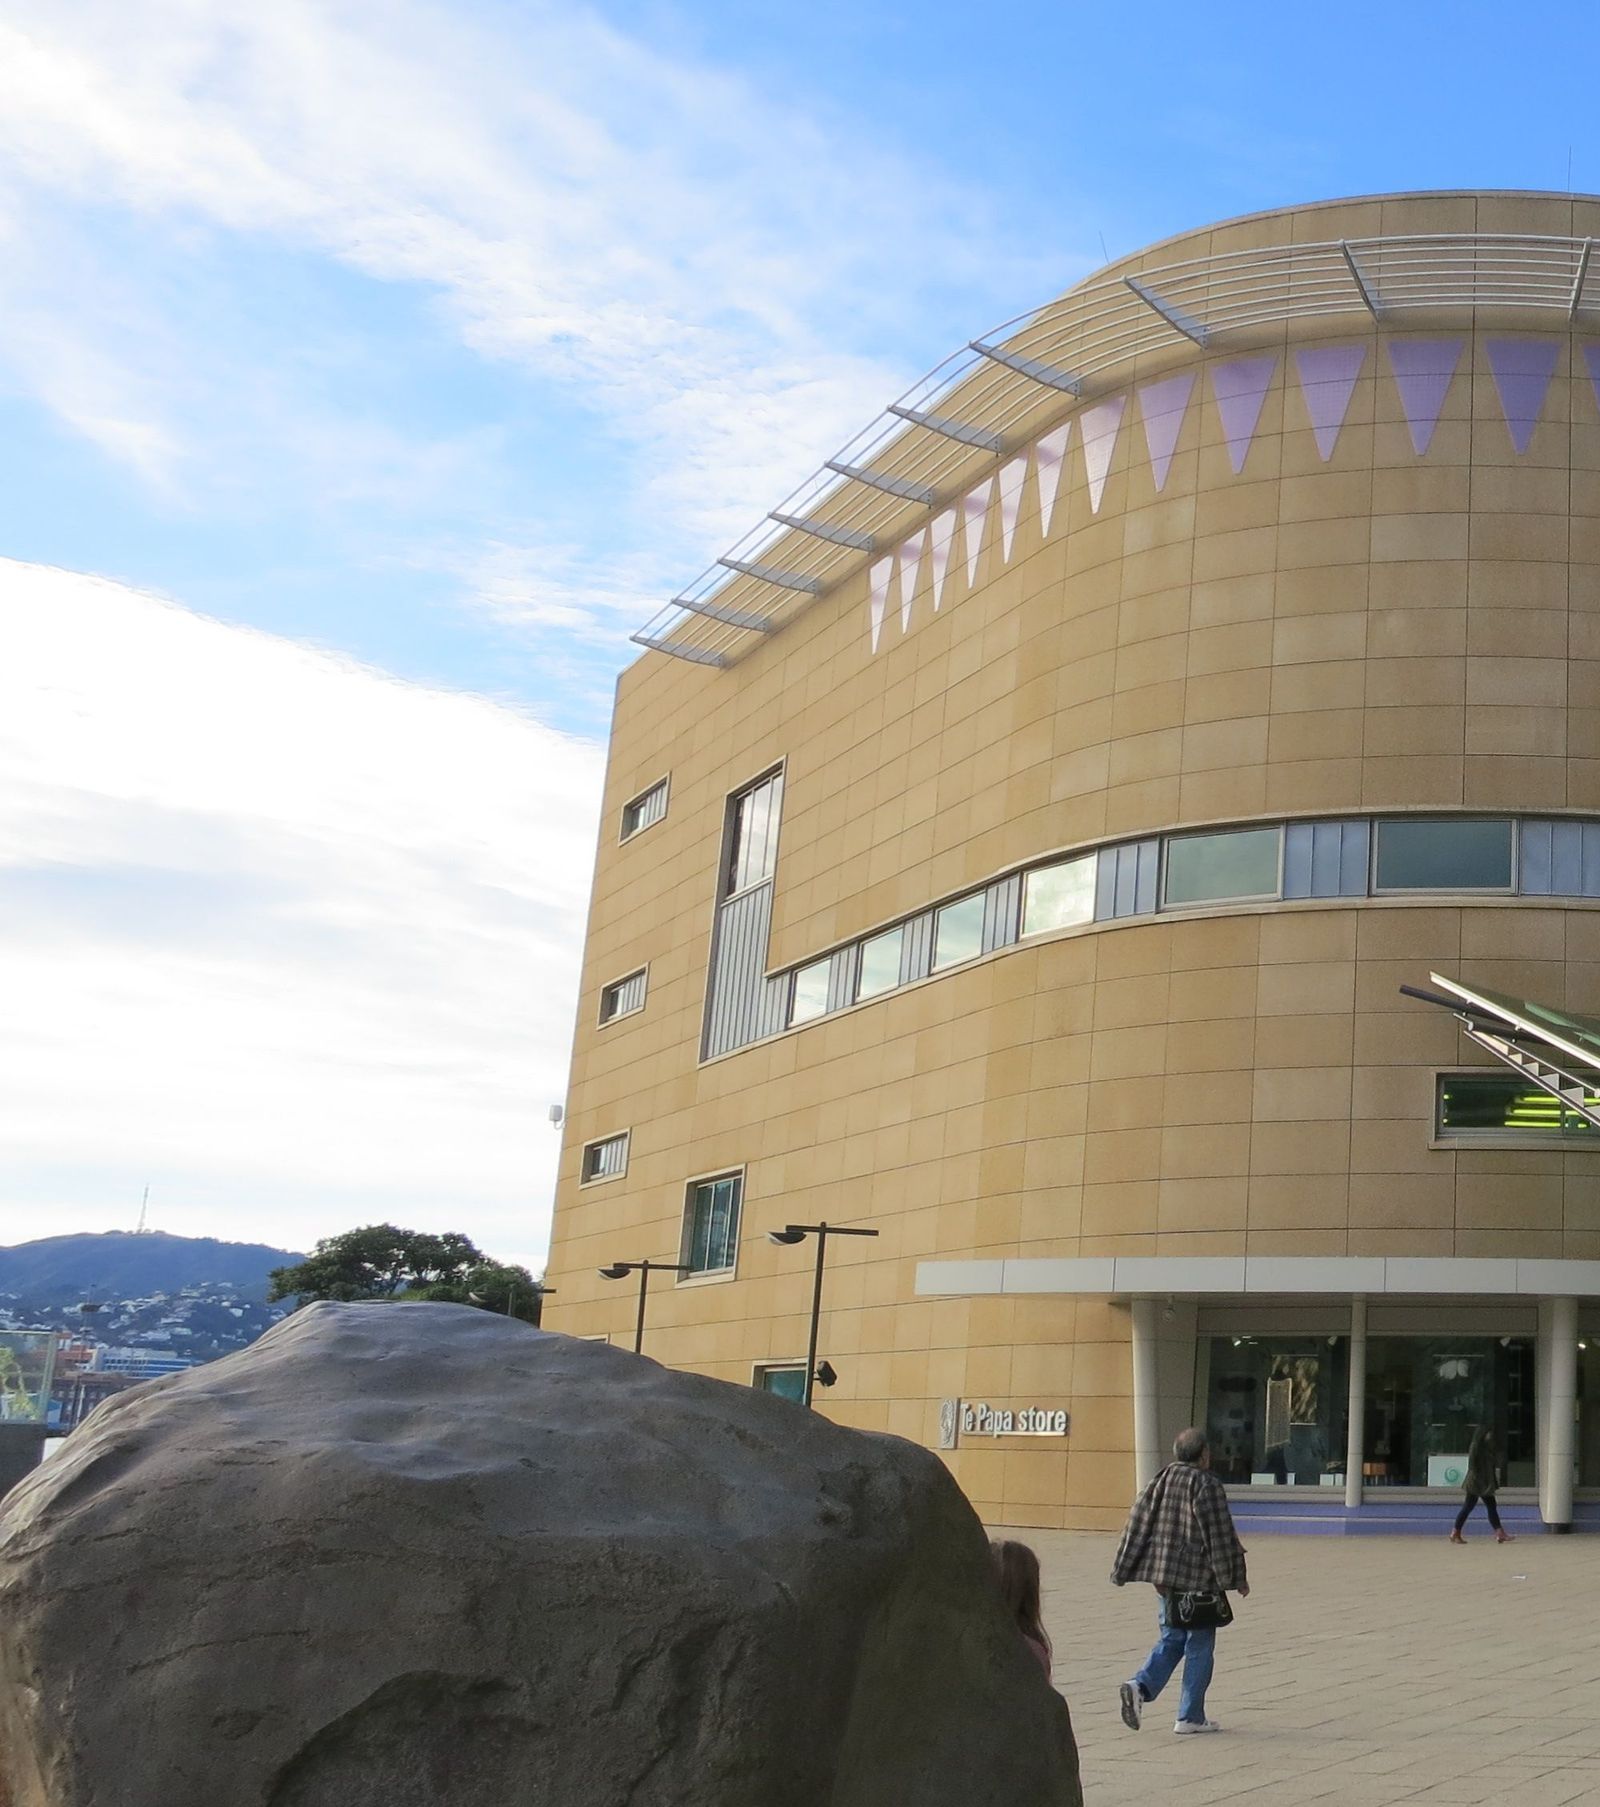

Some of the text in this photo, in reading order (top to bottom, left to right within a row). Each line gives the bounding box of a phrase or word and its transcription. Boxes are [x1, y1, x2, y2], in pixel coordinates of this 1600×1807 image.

[960, 1403, 1067, 1438] Te Papa store
